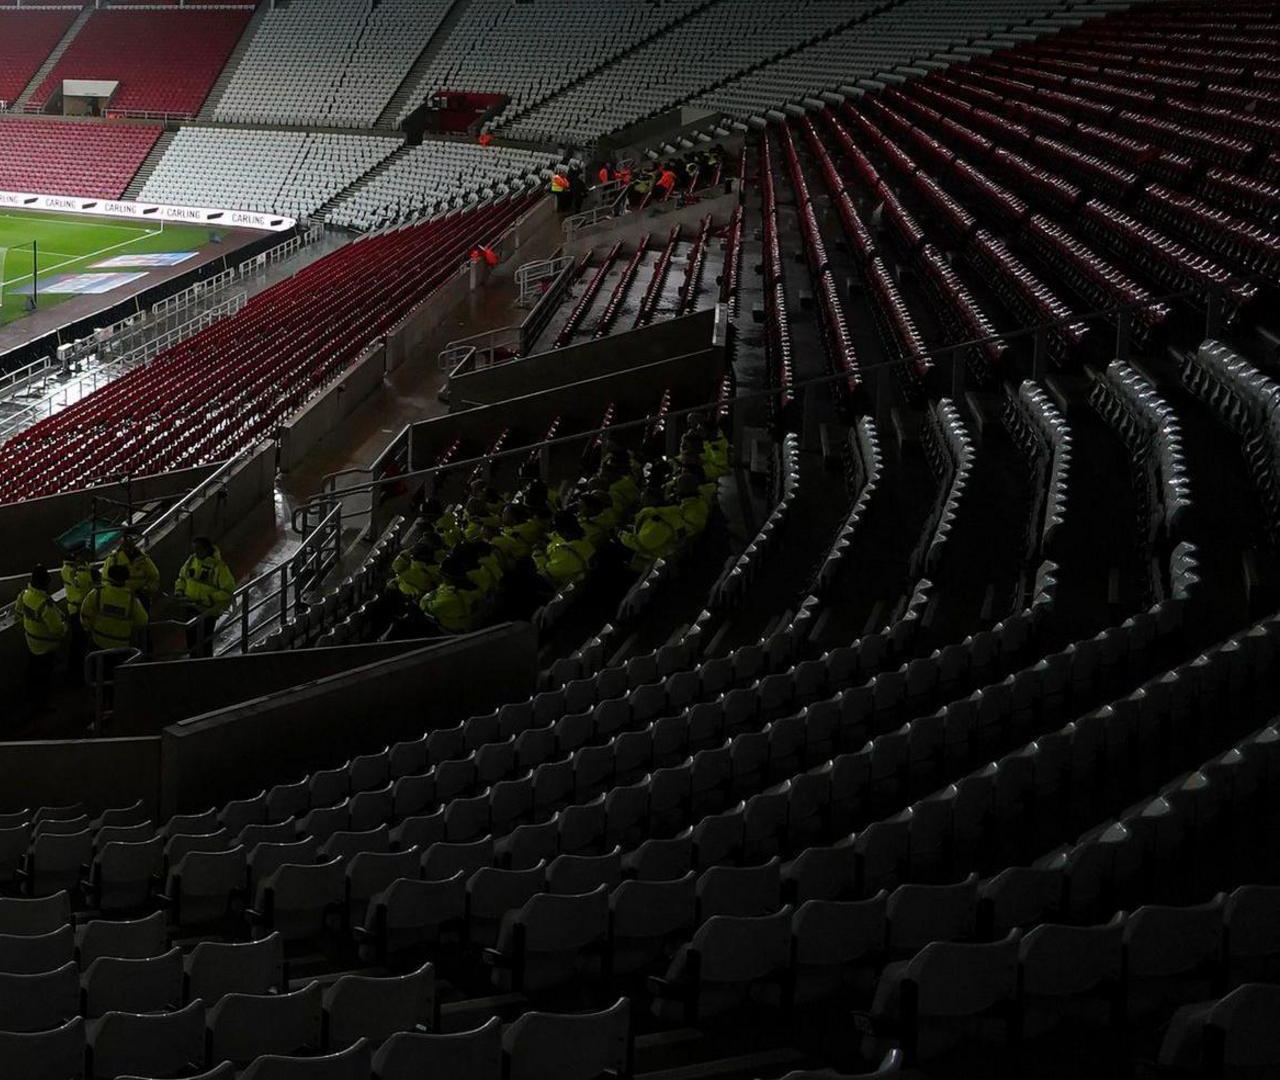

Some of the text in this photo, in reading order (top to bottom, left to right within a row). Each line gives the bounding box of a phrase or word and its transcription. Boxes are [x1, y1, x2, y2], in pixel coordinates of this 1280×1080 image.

[45, 198, 76, 209] CARLING
[104, 203, 137, 215] CARLING
[166, 208, 201, 220] CARLING
[231, 214, 265, 226] CARLING
